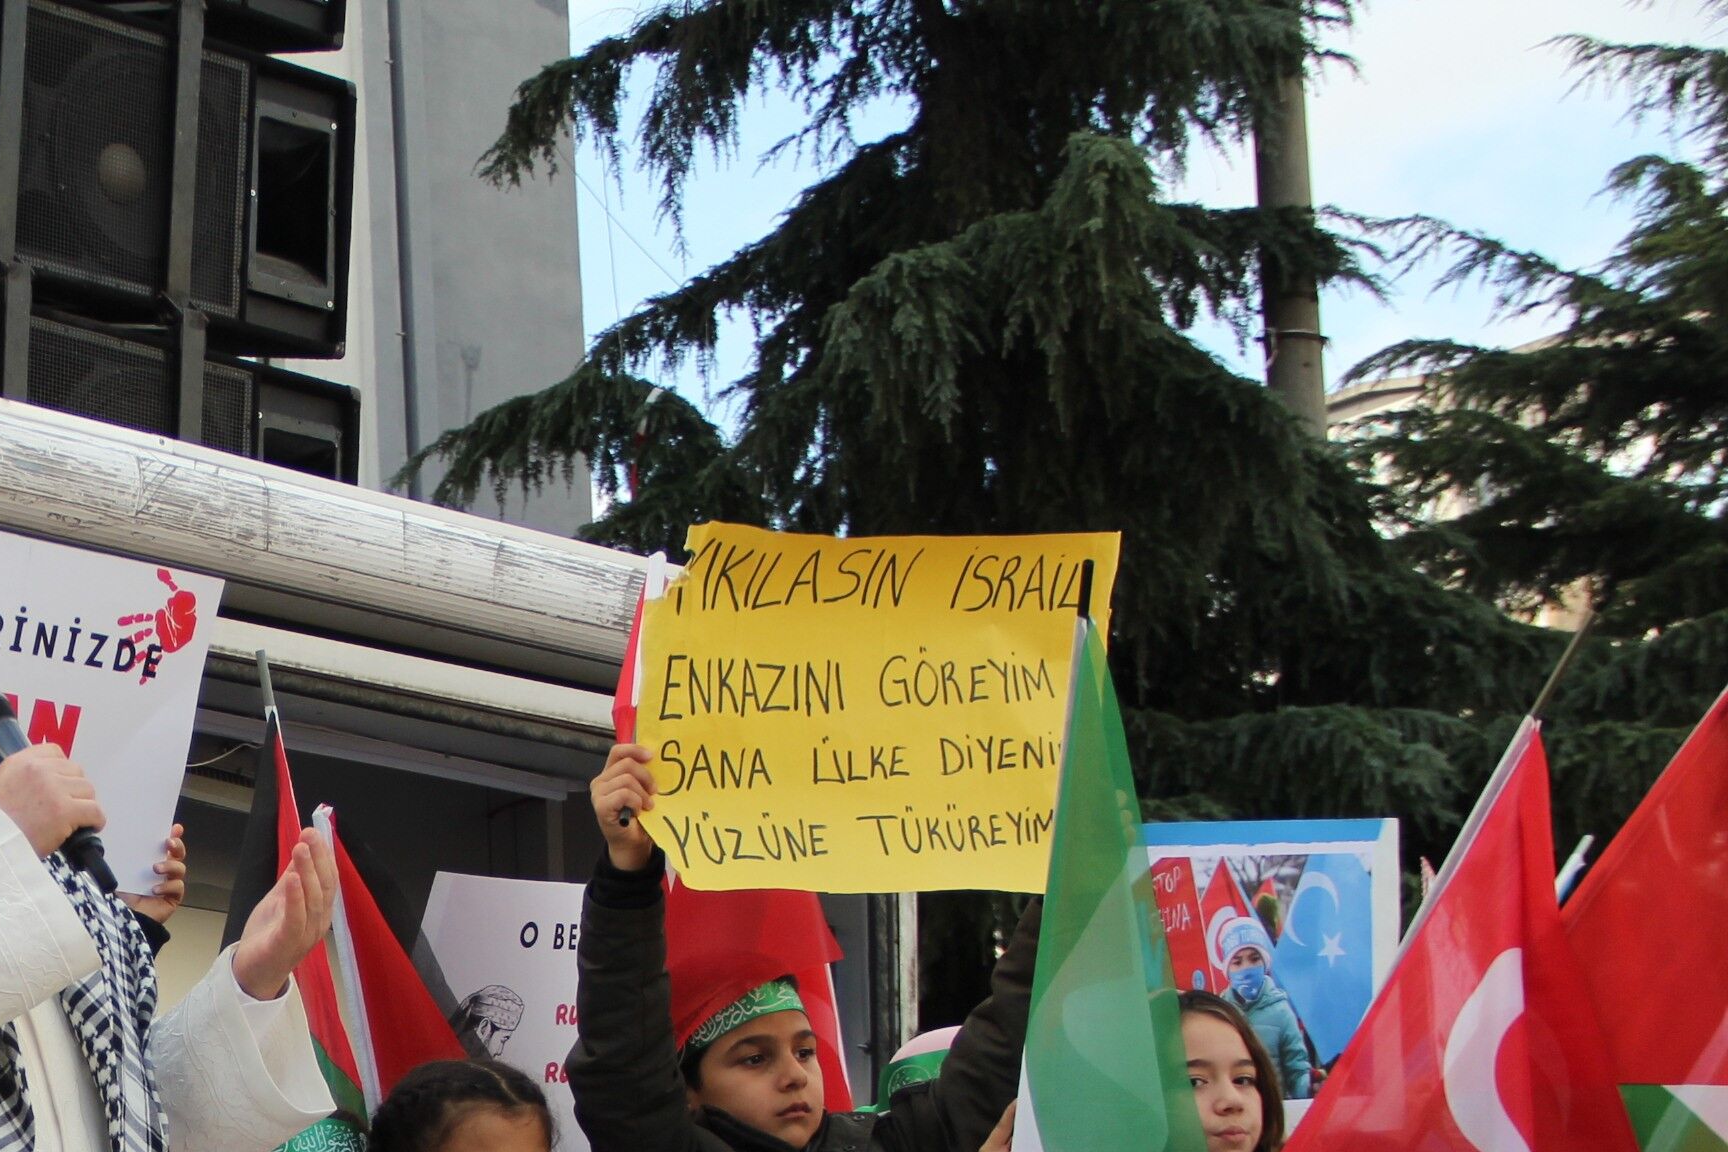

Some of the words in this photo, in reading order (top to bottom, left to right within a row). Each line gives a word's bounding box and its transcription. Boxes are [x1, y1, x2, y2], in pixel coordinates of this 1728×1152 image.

[949, 545, 1083, 612] İSRAİL
[658, 653, 846, 721] ENKAZINI
[878, 646, 1056, 708] GÖREYİM
[657, 738, 773, 797] SANA
[811, 735, 911, 785] ÜLKE
[939, 731, 1062, 777] DİYENİ
[662, 811, 829, 869] YÜZÜNE
[855, 804, 1054, 857] TÜKÜREYİM
[1152, 865, 1180, 893] TOP
[519, 921, 539, 949] O
[553, 923, 578, 950] BE
